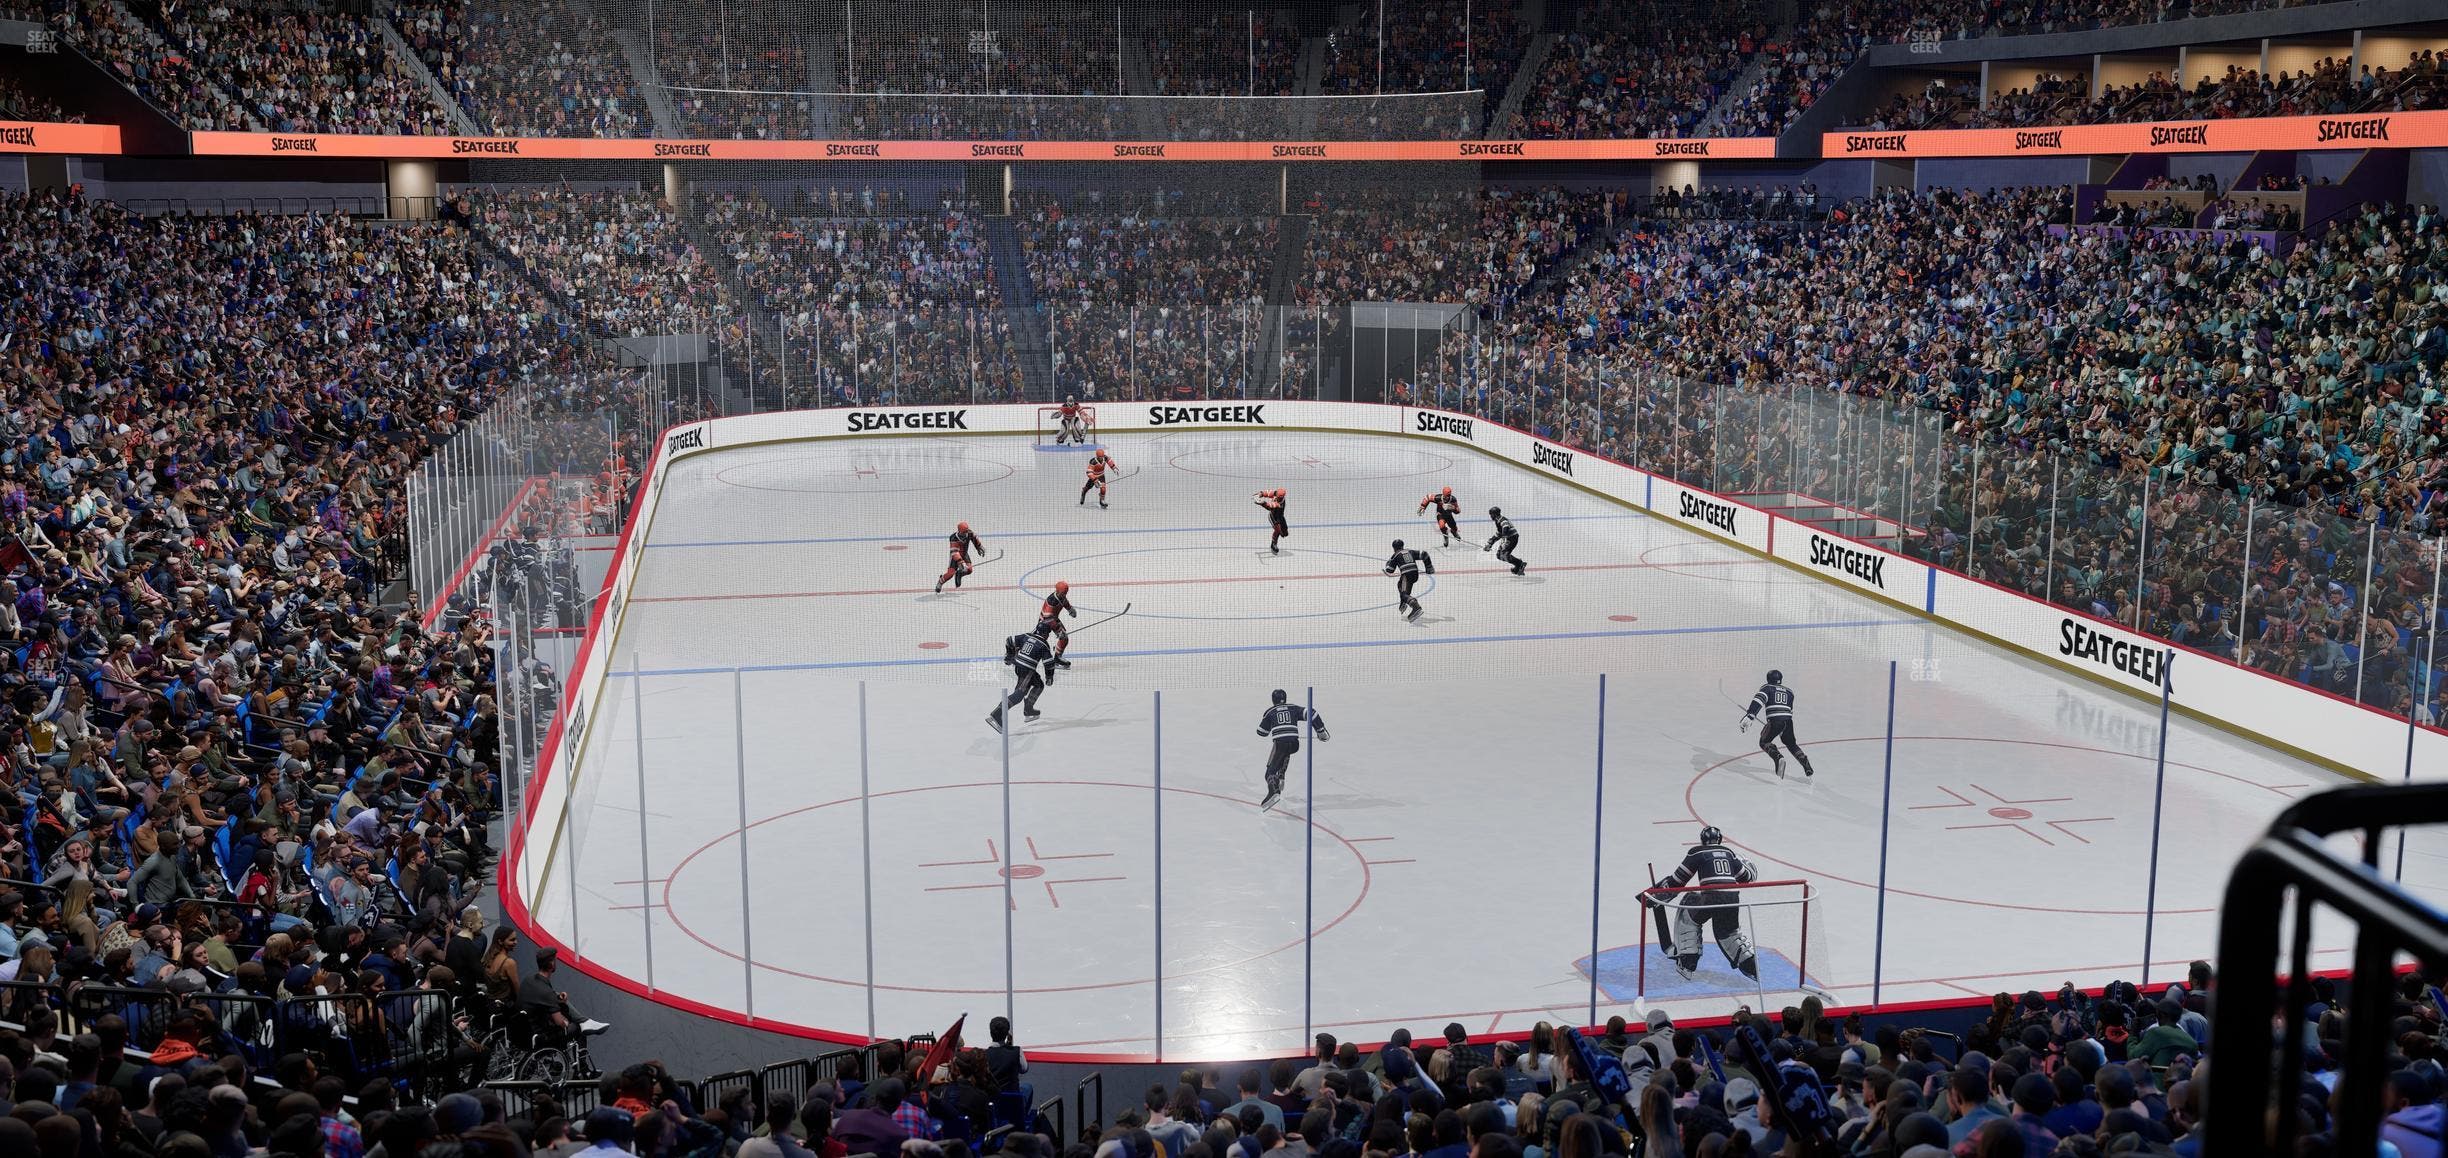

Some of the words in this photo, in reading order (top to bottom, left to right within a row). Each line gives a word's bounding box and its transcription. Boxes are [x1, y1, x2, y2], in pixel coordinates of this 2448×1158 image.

[2151, 124, 2208, 146] SEATGEEK
[2317, 118, 2390, 142] SEATGEEK
[272, 138, 317, 151] SEATGEEK
[453, 140, 518, 153] SEATGEEK
[1847, 135, 1906, 152] SEATGEEK
[2016, 130, 2062, 149] SEATGEEK
[655, 144, 710, 156] SEATGEEK
[827, 144, 879, 156] SEATGEEK
[972, 145, 1023, 156] SEATGEEK
[1115, 145, 1164, 156] SEATGEEK
[1273, 145, 1325, 157] SEATGEEK
[1460, 143, 1524, 155] SEATGEEK
[1656, 142, 1709, 155] SEATGEEK
[848, 410, 967, 432] SEATGEEK
[1150, 405, 1265, 425] SEATGEEK
[1418, 412, 1473, 441] SEATGEEK
[1533, 442, 1573, 477] SEATGEEK
[1680, 491, 1737, 537] SEATGEEK
[1811, 535, 1885, 590] SEATGEEK
[2059, 618, 2176, 694] SEATGEEK
[1277, 711, 1291, 723] 00
[1713, 859, 1731, 874] 00
